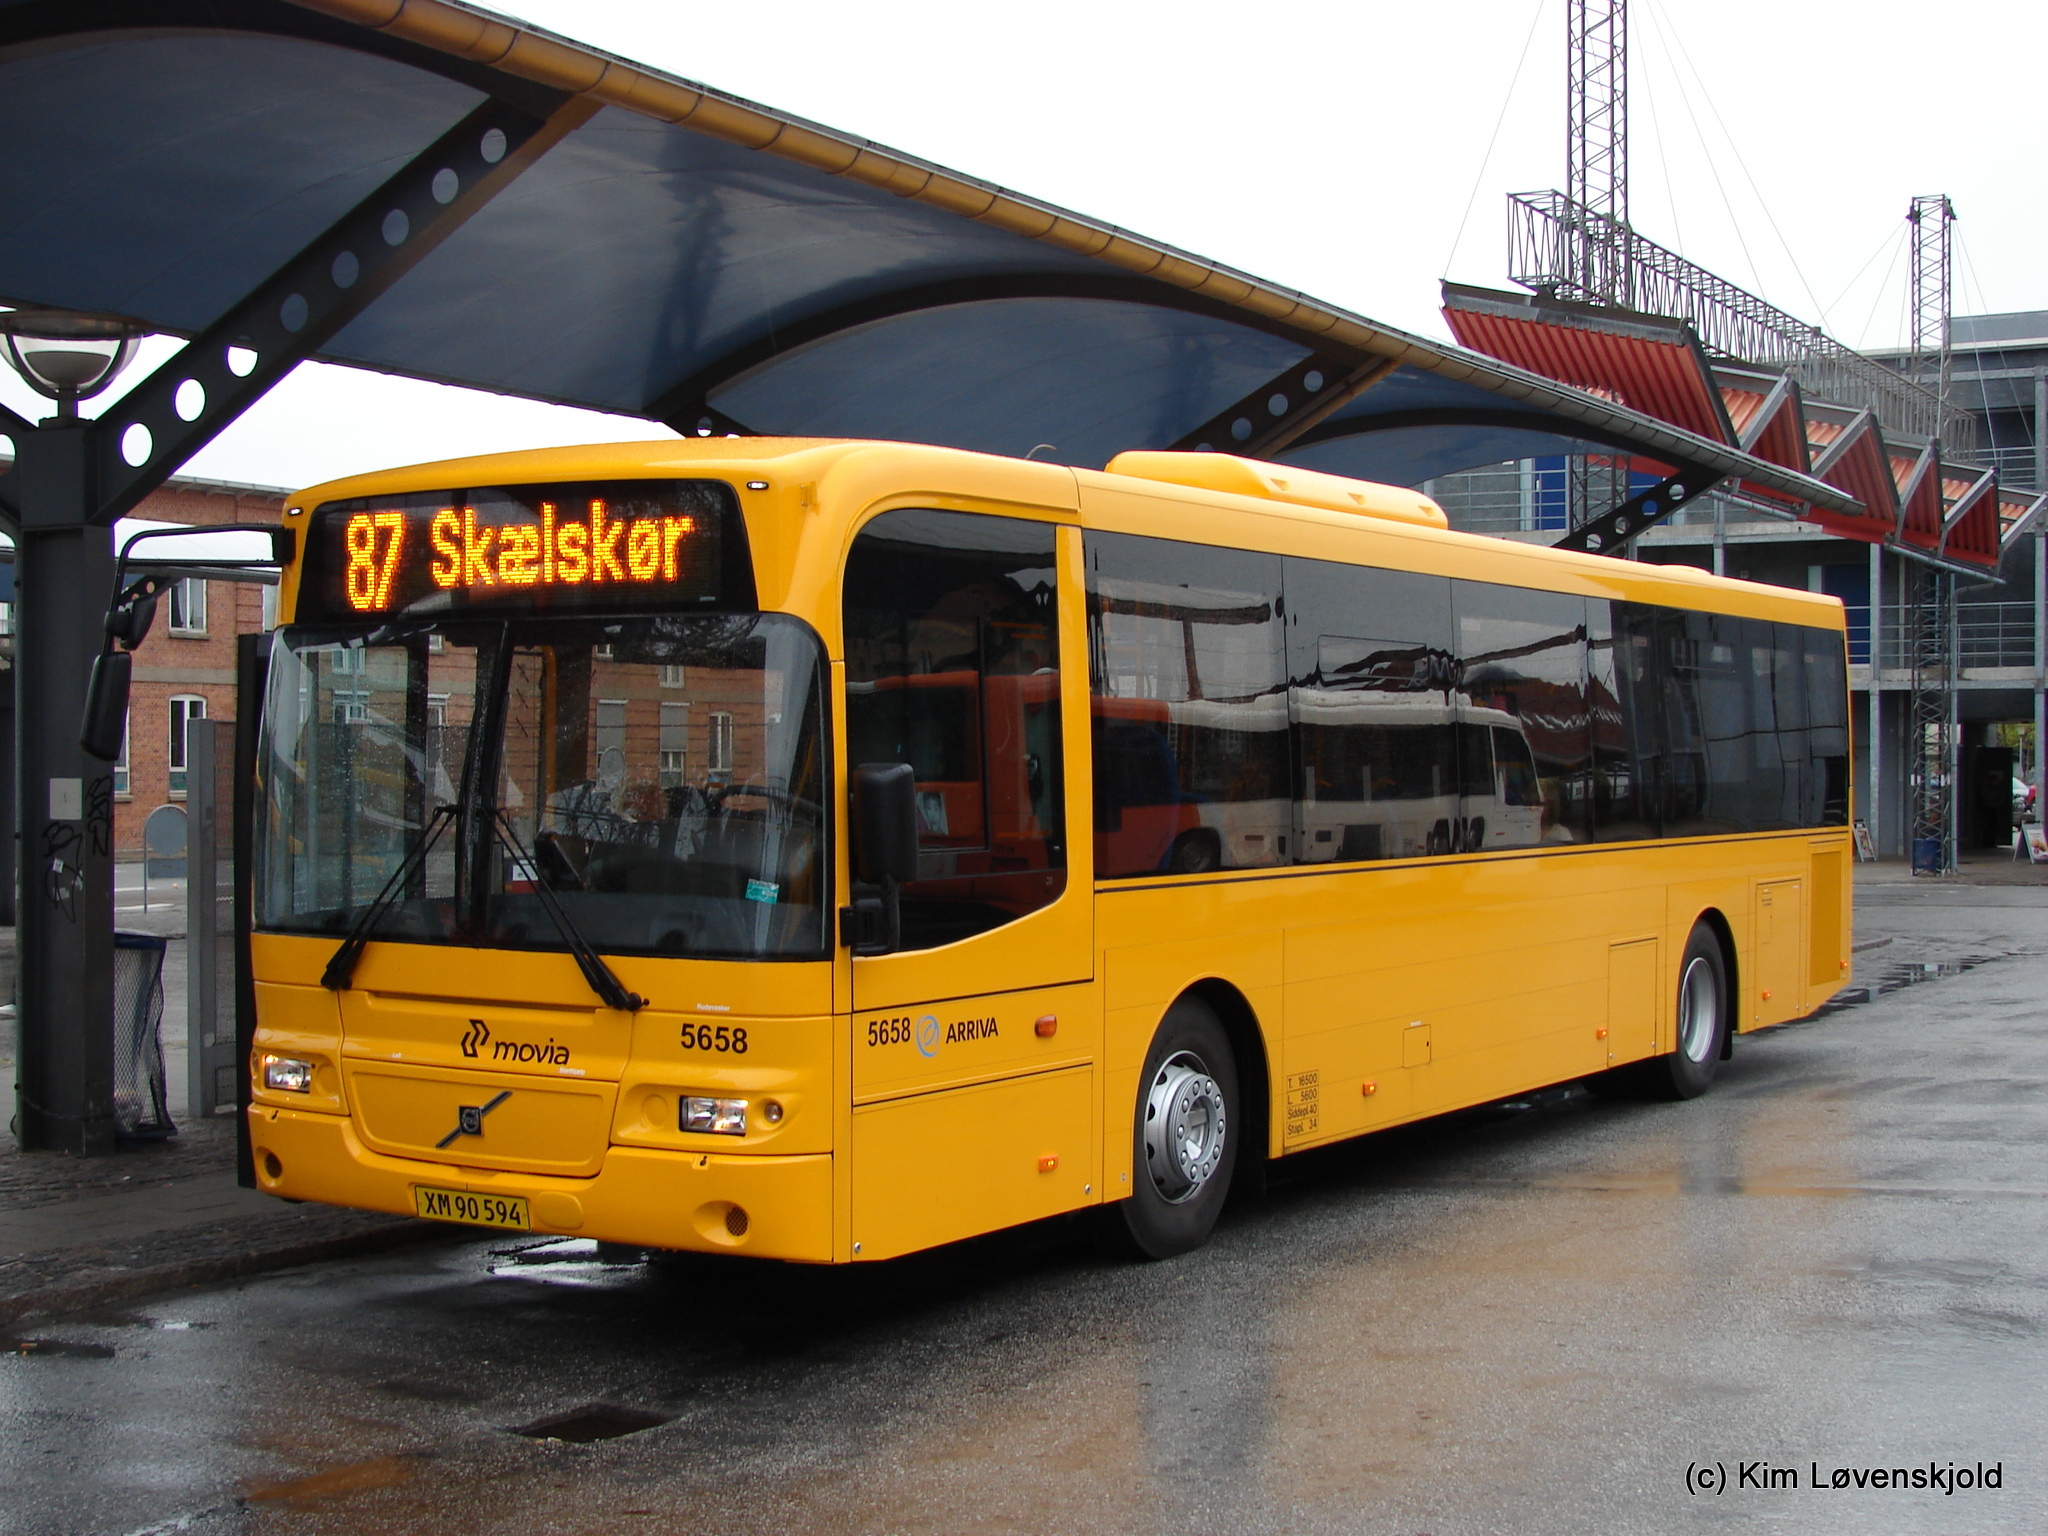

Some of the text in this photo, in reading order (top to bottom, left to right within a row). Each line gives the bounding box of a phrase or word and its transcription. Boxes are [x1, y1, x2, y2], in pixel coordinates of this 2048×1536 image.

[346, 499, 696, 611] 87 Skælskør
[680, 1022, 749, 1054] 5658
[867, 1017, 999, 1047] 5658 ARRIVA
[493, 1037, 570, 1065] movia
[1299, 1073, 1318, 1087] 16500
[1301, 1088, 1317, 1102] 5600
[1309, 1103, 1317, 1115] 40
[1309, 1118, 1317, 1130] 34
[424, 1191, 521, 1226] XM 90 594
